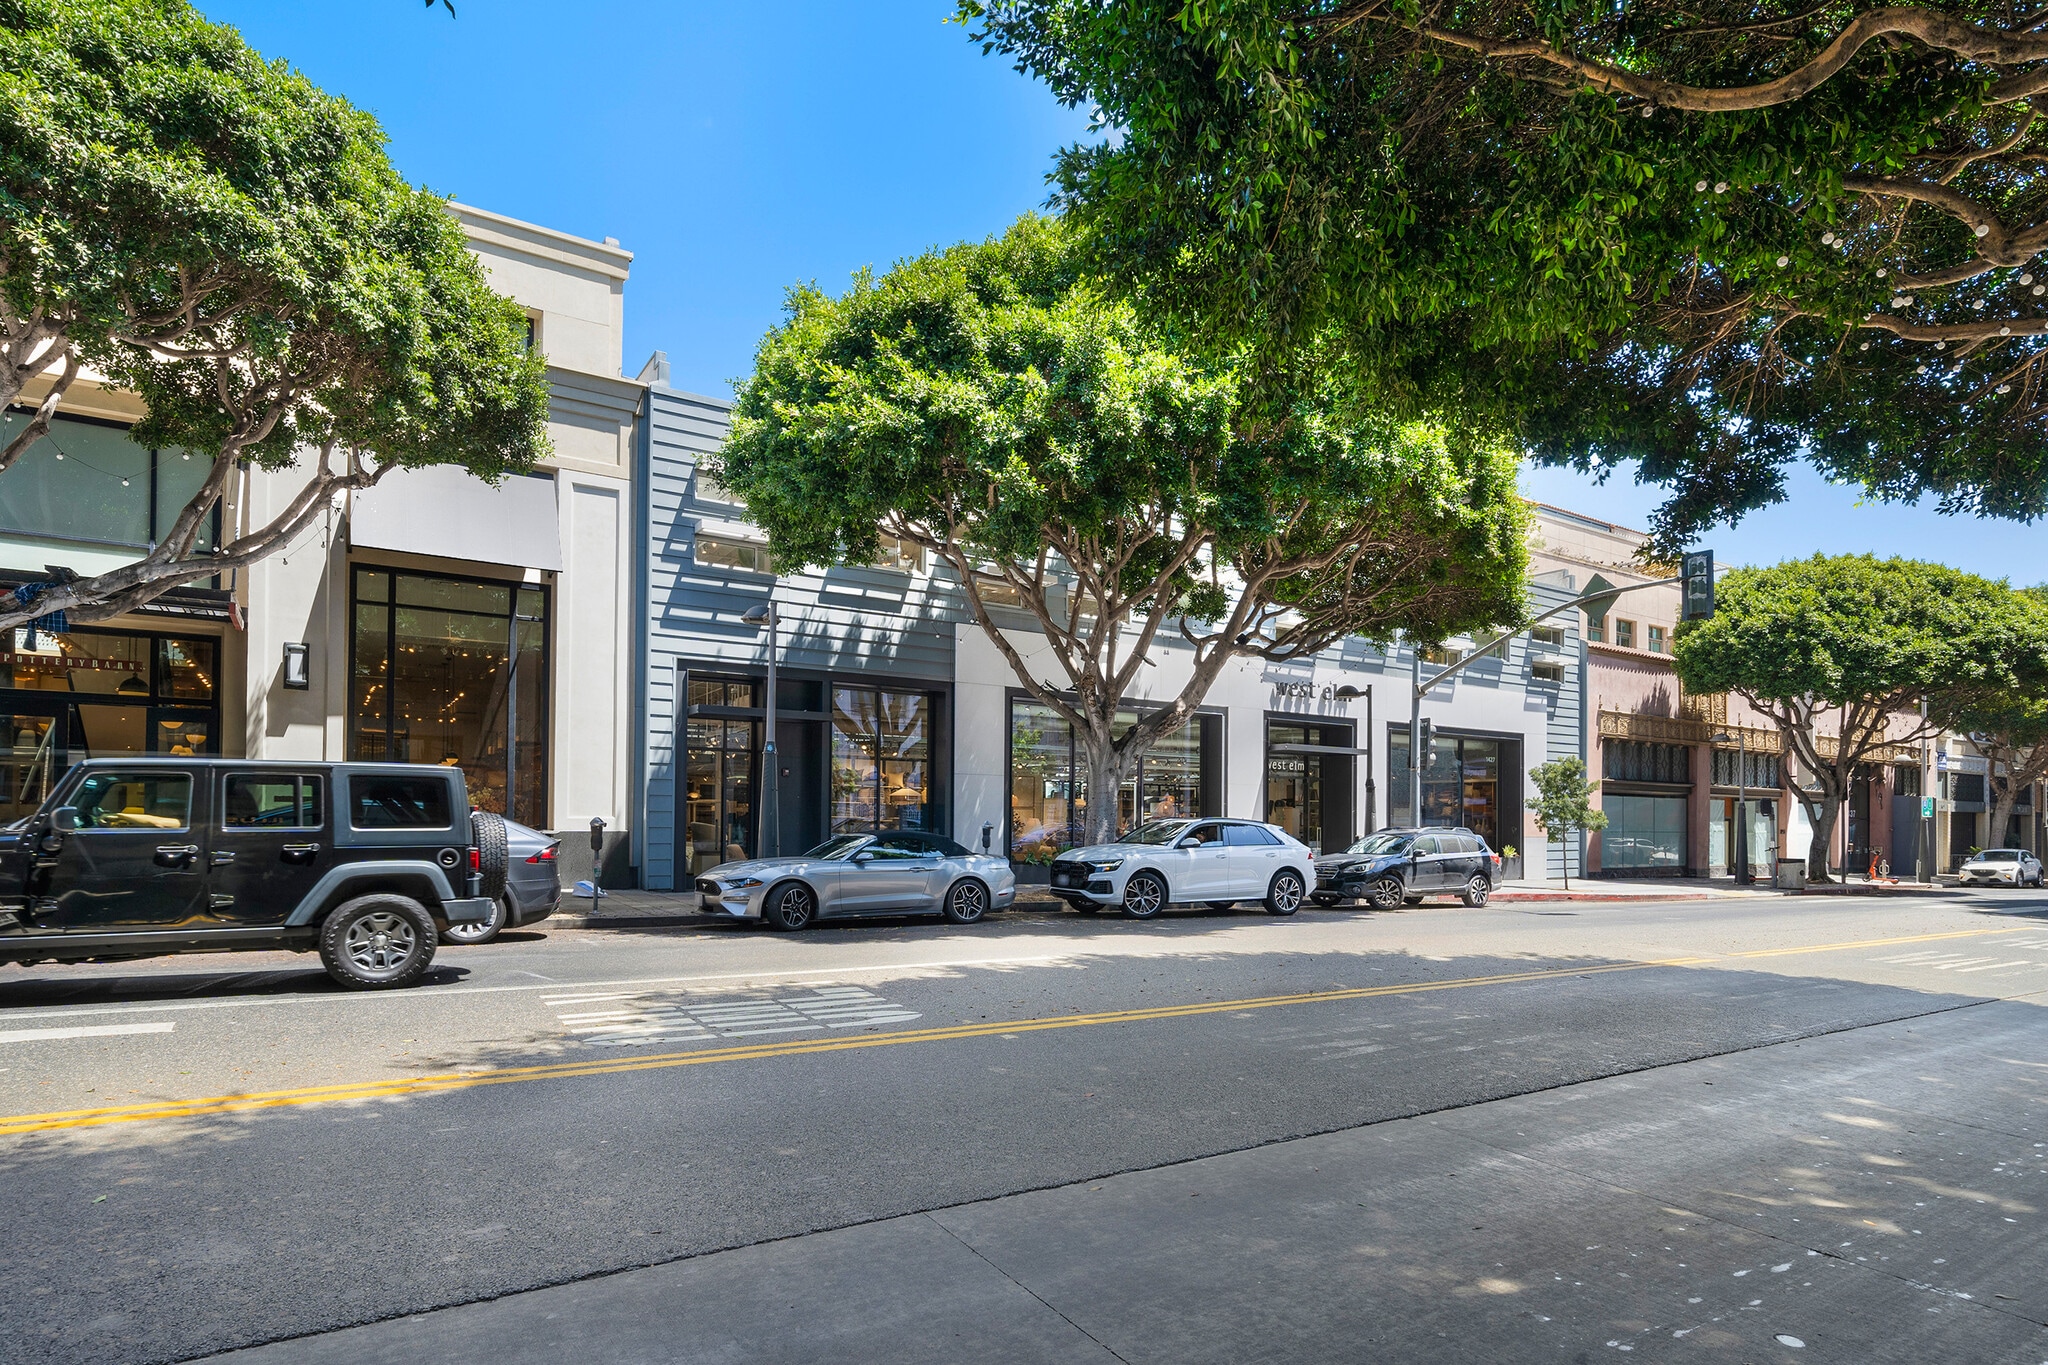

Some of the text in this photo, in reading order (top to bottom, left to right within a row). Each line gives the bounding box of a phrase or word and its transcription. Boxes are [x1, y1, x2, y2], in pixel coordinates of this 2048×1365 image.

[1275, 682, 1352, 702] west el
[1288, 760, 1305, 771] elm
